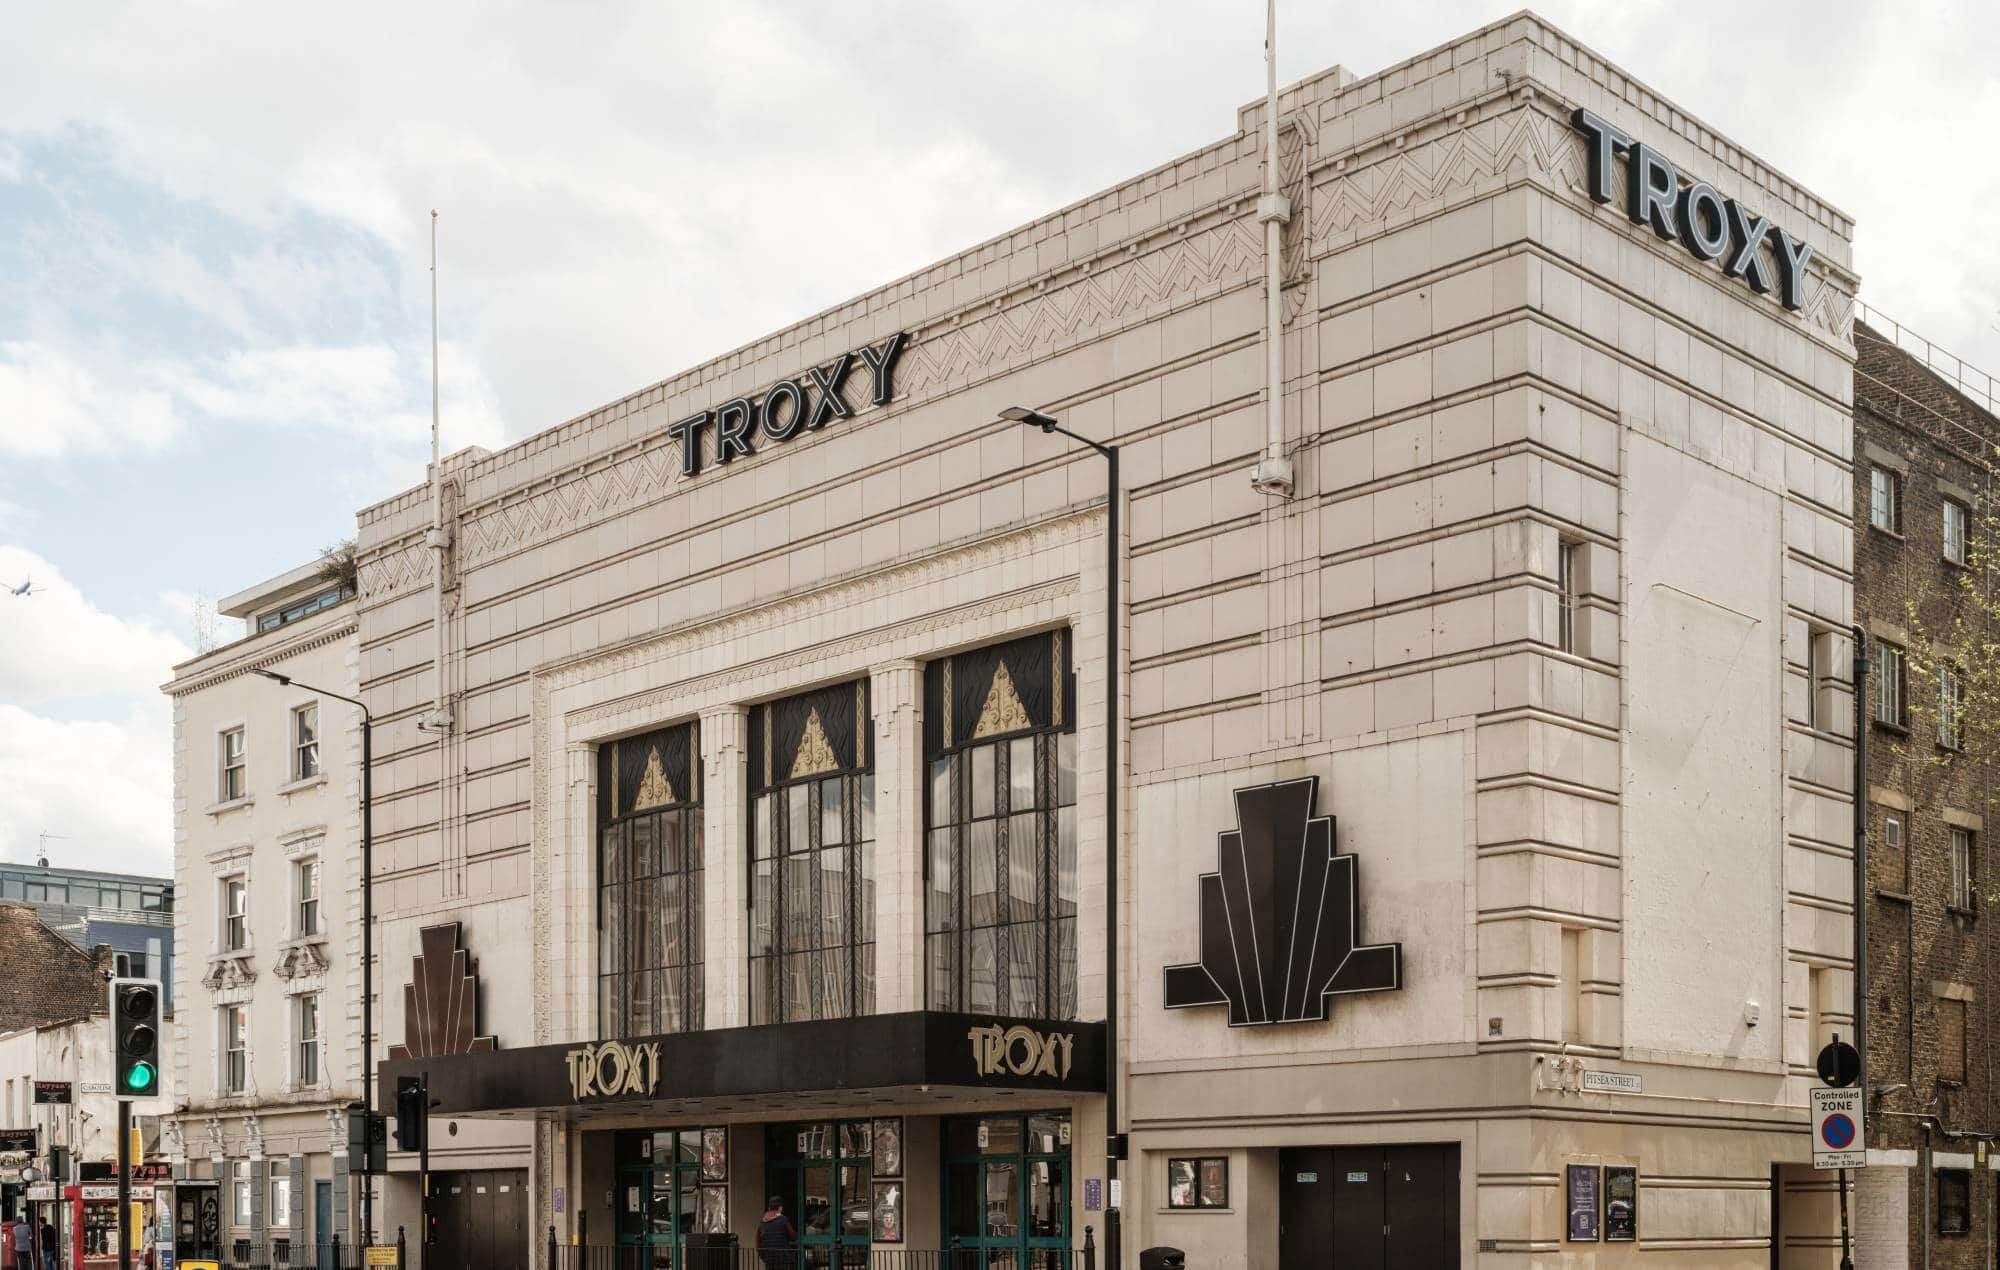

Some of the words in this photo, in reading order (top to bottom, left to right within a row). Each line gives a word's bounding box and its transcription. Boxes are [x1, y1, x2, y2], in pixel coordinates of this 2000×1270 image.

[1571, 107, 1813, 311] TROXY
[669, 332, 908, 477] TROXY
[968, 1023, 1074, 1082] TROXY
[565, 1040, 662, 1103] TROXY
[1586, 1073, 1610, 1086] PITSEA
[1610, 1076, 1635, 1088] STREET
[1814, 1091, 1859, 1100] Controlled
[1821, 1101, 1853, 1112] ZONE
[799, 1136, 805, 1148] 3
